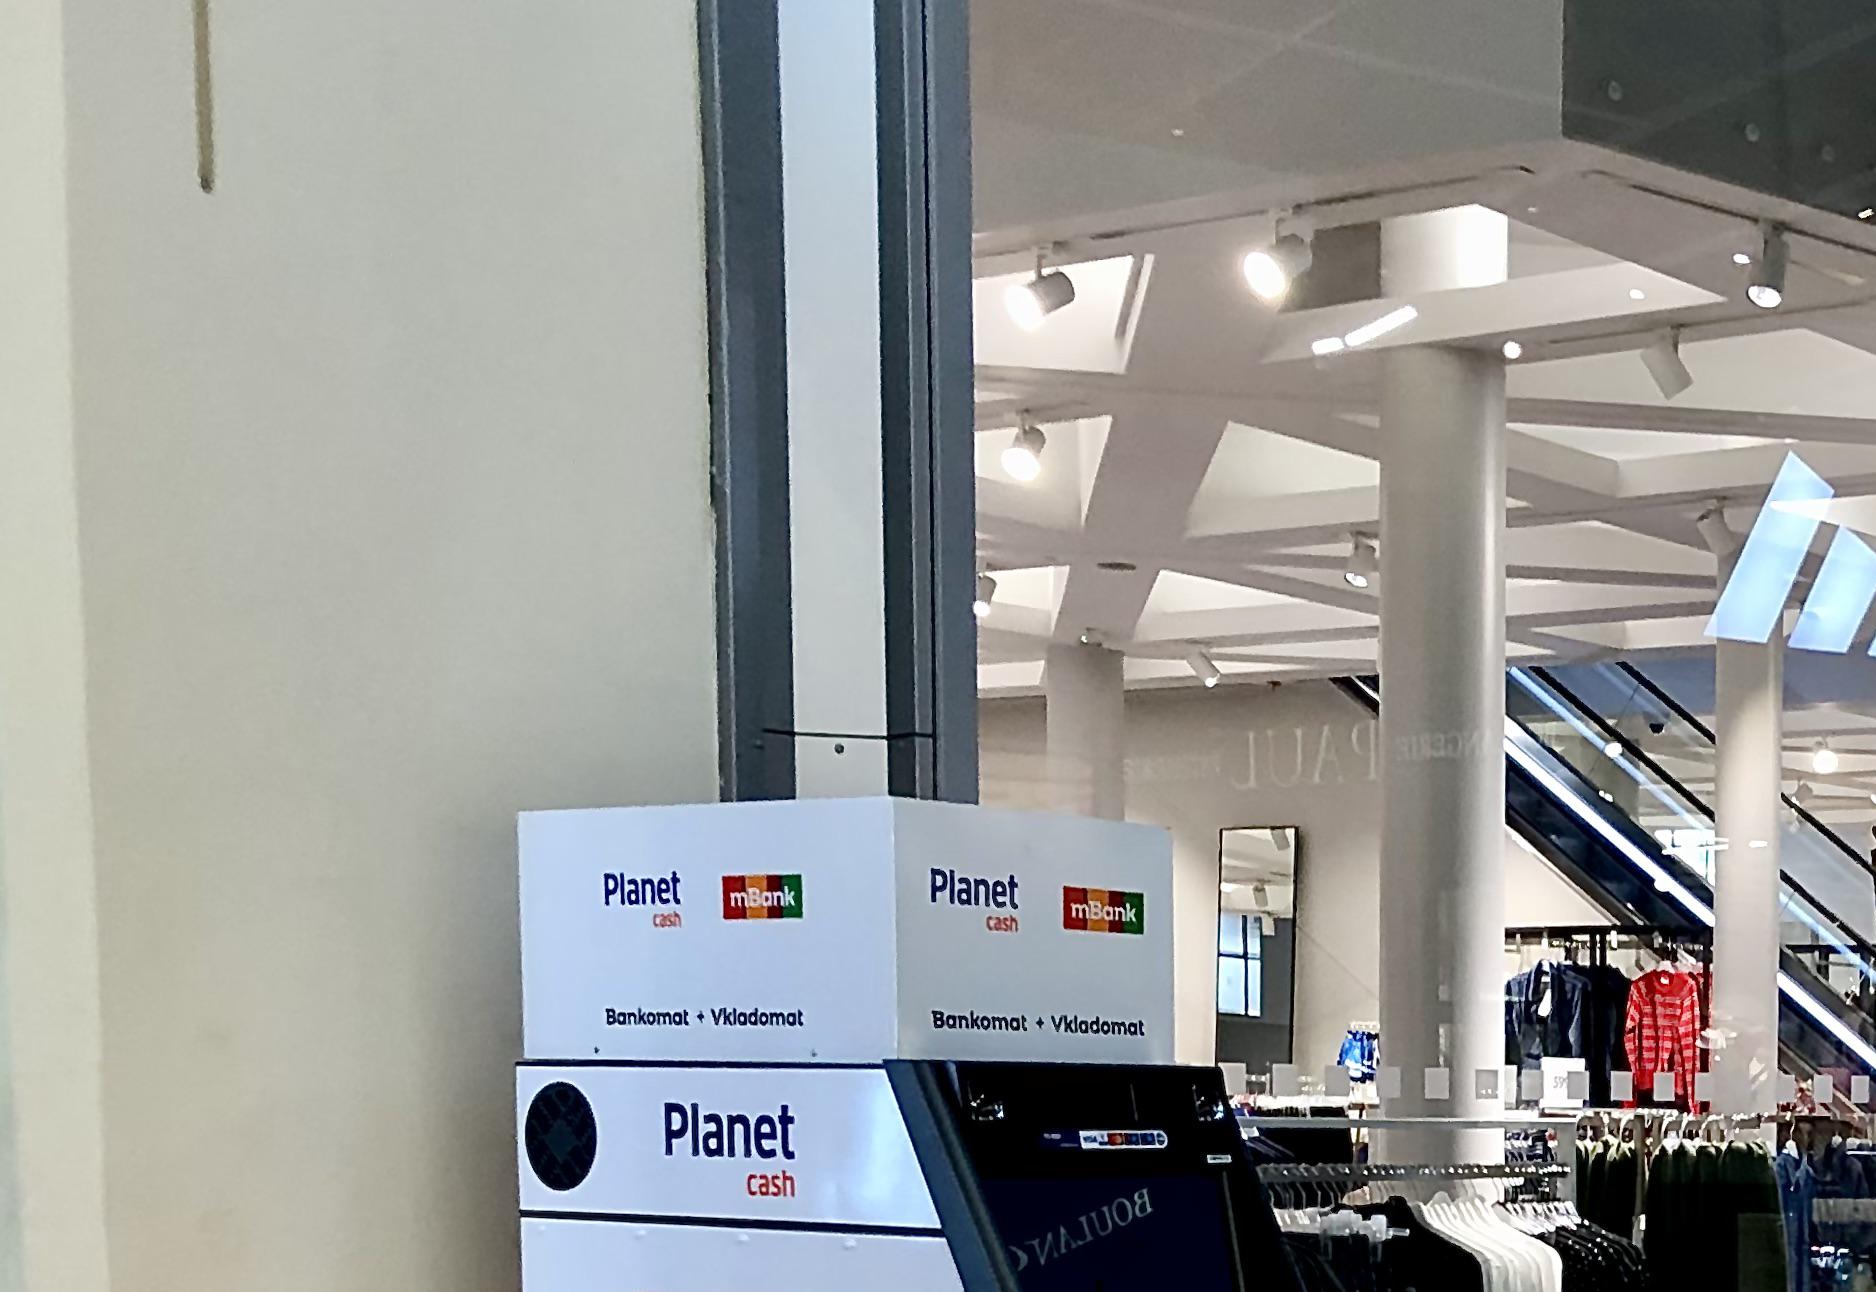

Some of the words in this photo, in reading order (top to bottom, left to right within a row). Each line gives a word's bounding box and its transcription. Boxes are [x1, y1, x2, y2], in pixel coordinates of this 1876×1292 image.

[603, 871, 681, 907] Planet
[729, 884, 796, 910] mBank
[930, 868, 1020, 910] Planet
[652, 911, 682, 928] cash
[985, 913, 1019, 933] cash
[1070, 899, 1137, 925] mBank
[605, 1007, 690, 1026] Bankomat
[711, 1007, 804, 1027] Vkladomat
[931, 1009, 1028, 1032] Bankomat
[1035, 1015, 1045, 1028] +
[1051, 1014, 1145, 1037] Vkladomat
[664, 1101, 796, 1160] Planet
[746, 1168, 796, 1197] cash
